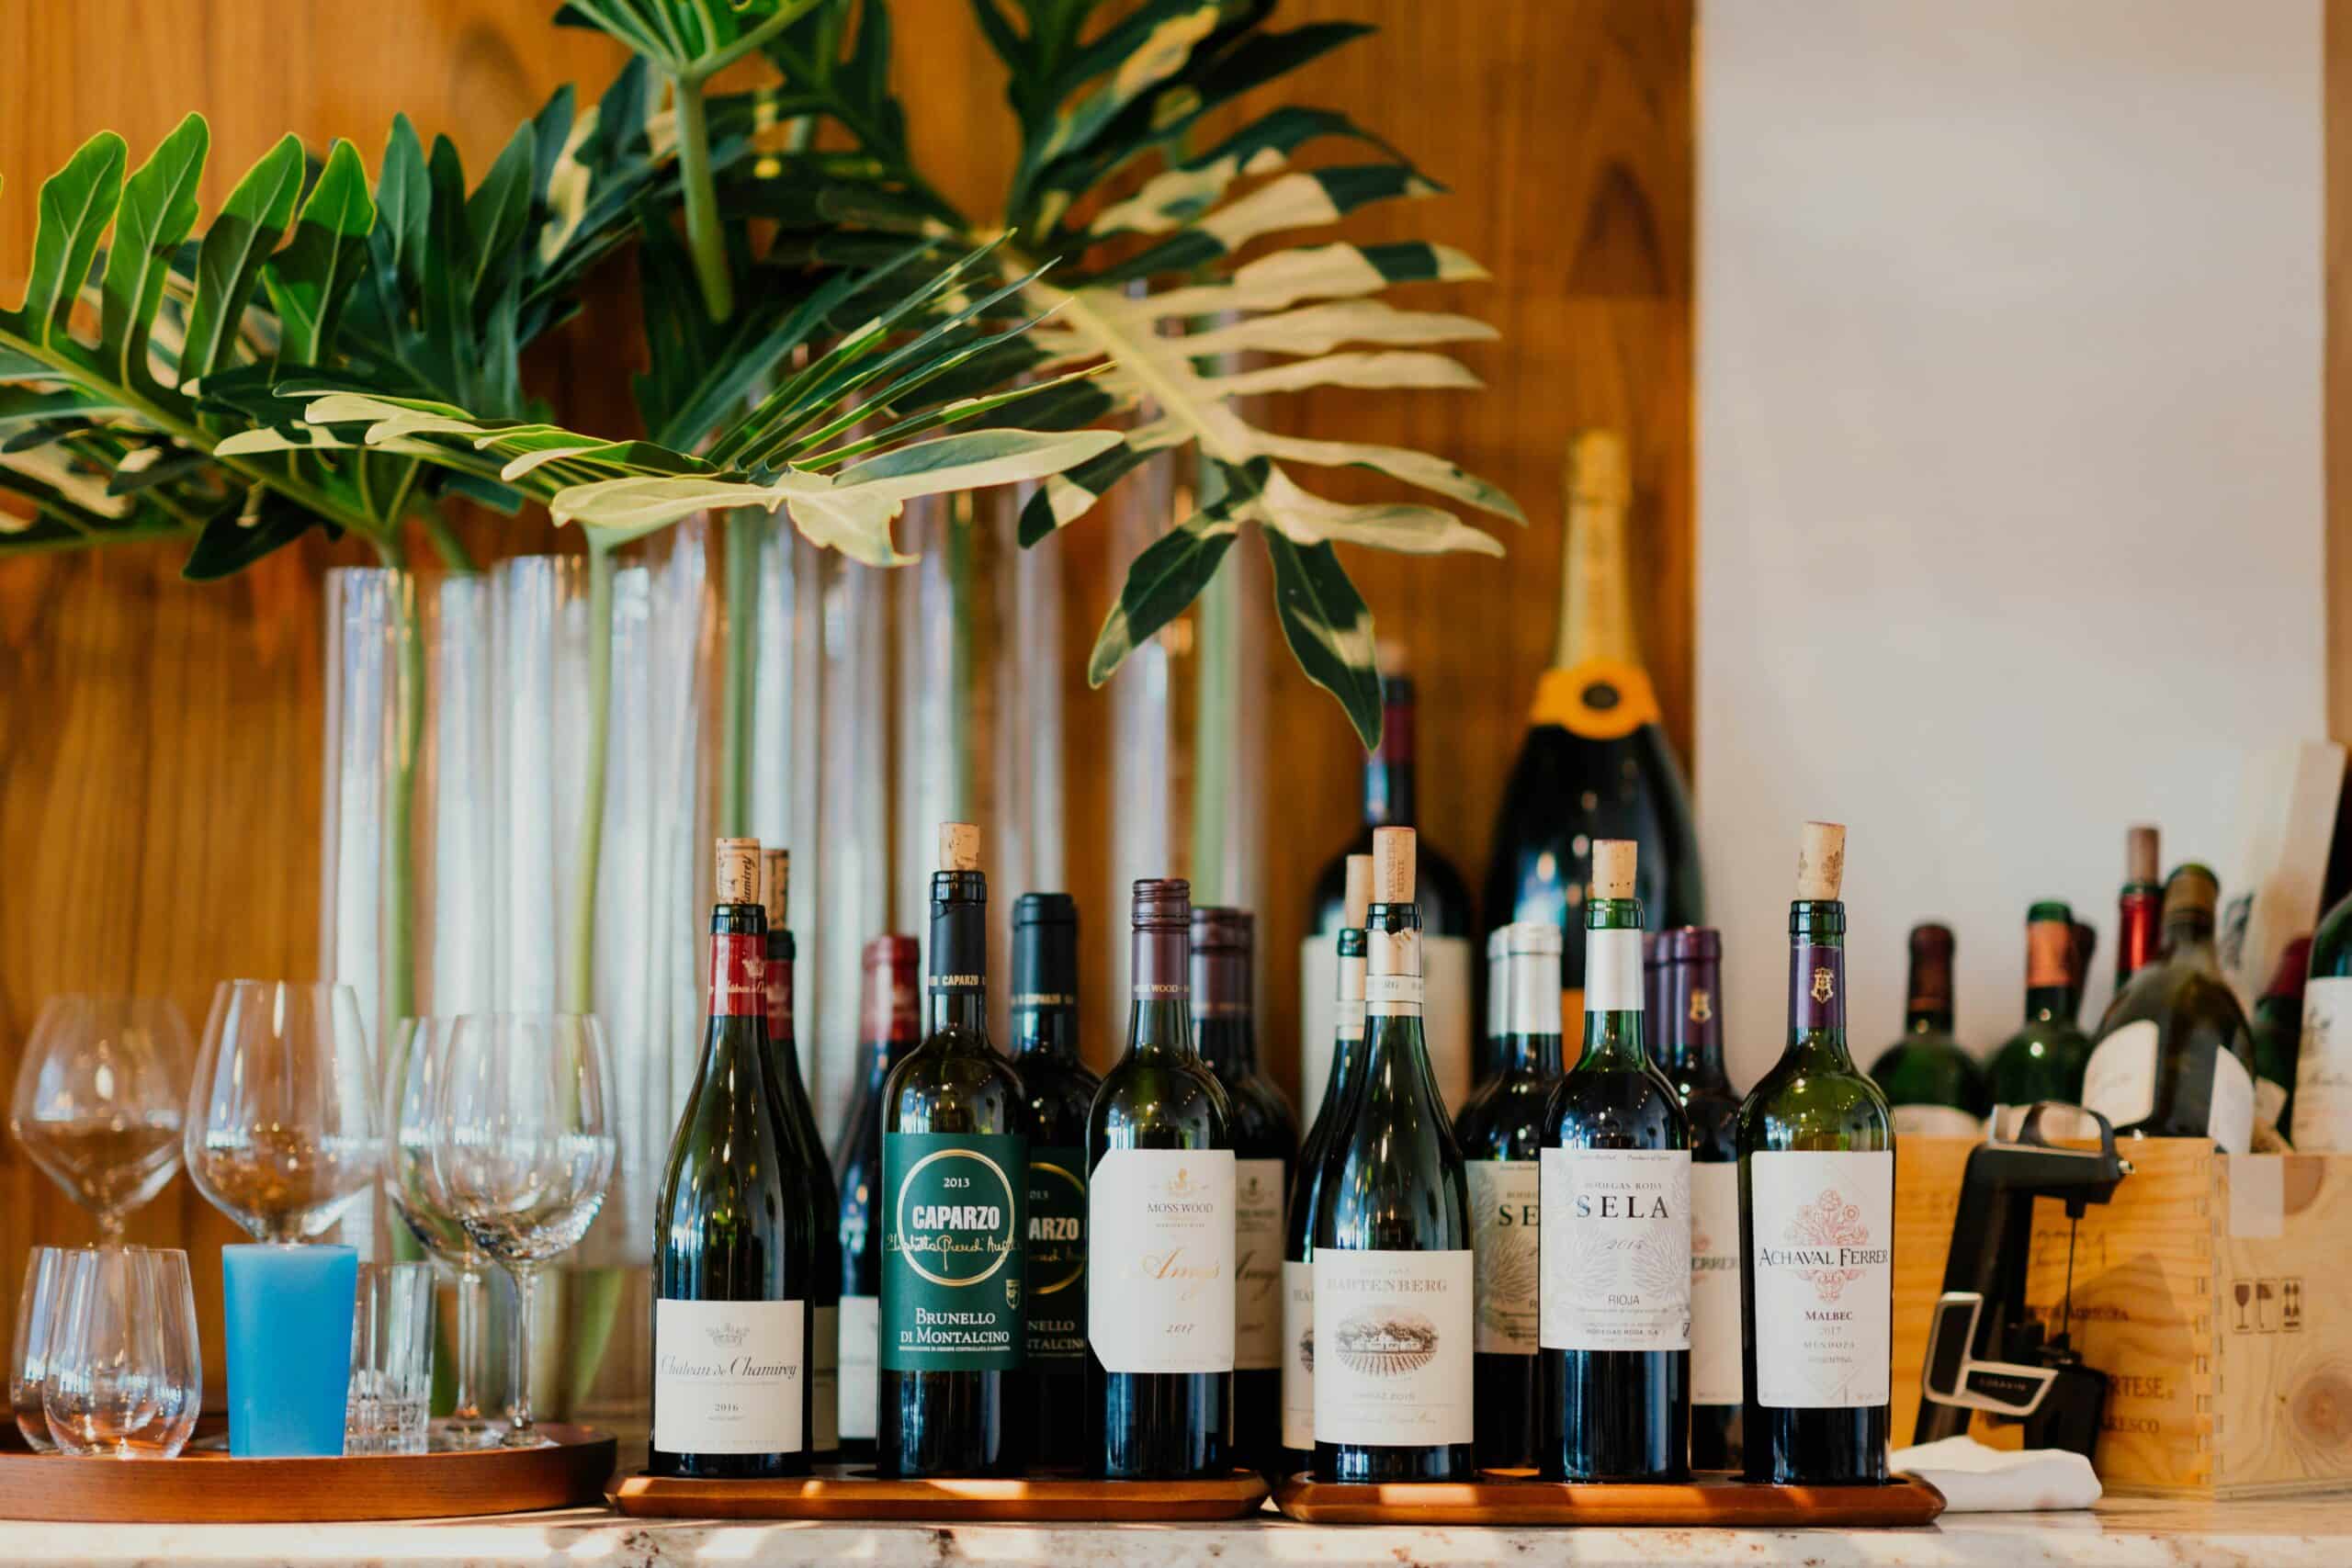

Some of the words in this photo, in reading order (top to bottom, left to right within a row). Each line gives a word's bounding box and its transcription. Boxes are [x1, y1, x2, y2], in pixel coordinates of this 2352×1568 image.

[739, 854, 756, 904] hamirey
[941, 975, 979, 987] CAPARZO
[943, 1177, 970, 1189] 2013
[1148, 1202, 1178, 1213] MOSS
[1181, 1202, 1214, 1213] WOOD
[1577, 1195, 1669, 1219] SELA
[911, 1205, 1001, 1230] CAPARZO
[1498, 1204, 1539, 1226] SE
[1028, 1217, 1080, 1240] ARZO
[1691, 1256, 1739, 1271] ERRER
[1759, 1248, 1835, 1267] ACHAVAL
[1840, 1248, 1889, 1267] FERRER
[1608, 1294, 1640, 1305] RIOJA
[915, 1307, 996, 1325] BRUNELLO
[1805, 1310, 1853, 1322] MALBEC
[1028, 1320, 1075, 1332] NELLO
[917, 1325, 1010, 1343] MONTALCINO
[1027, 1338, 1085, 1351] TALCIN
[714, 1403, 740, 1412] 2016
